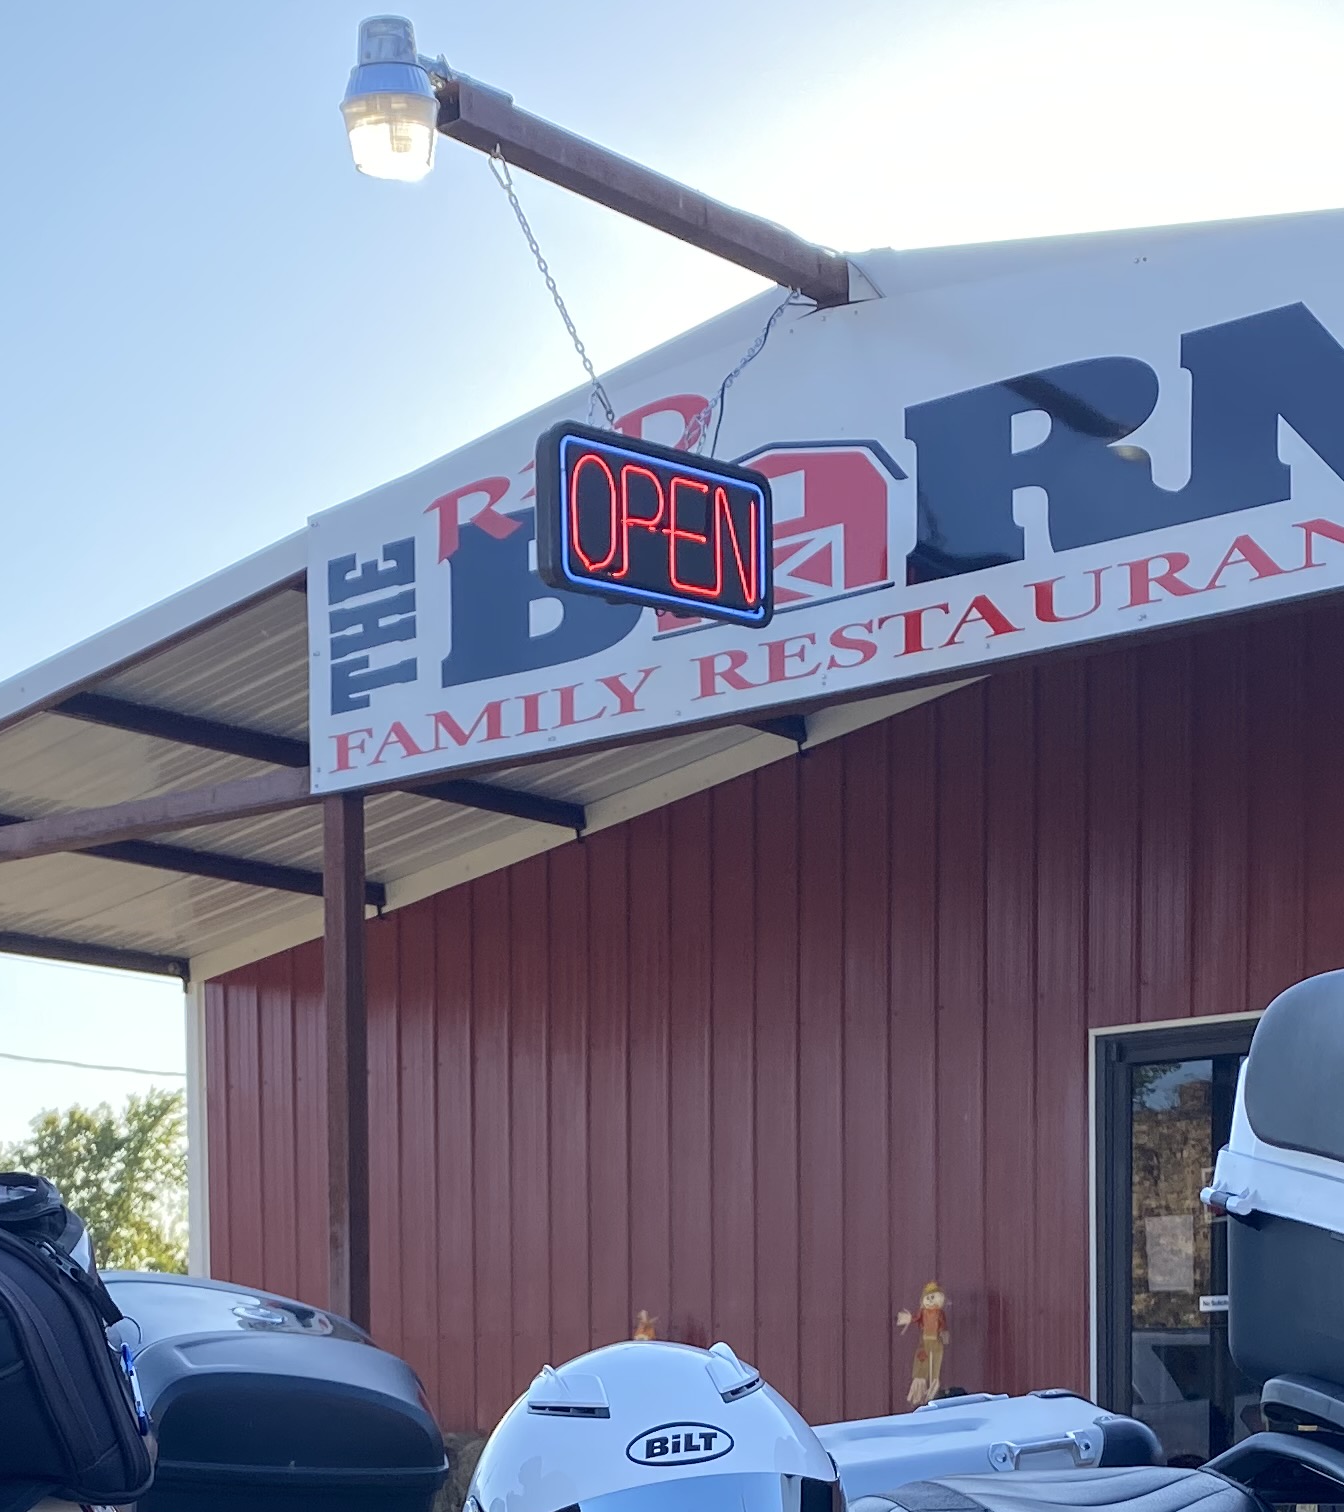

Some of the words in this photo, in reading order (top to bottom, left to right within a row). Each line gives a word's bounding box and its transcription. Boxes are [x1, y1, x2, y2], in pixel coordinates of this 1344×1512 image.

[571, 454, 755, 605] OPEN
[328, 535, 417, 717] THE
[329, 665, 662, 774] FAMILY
